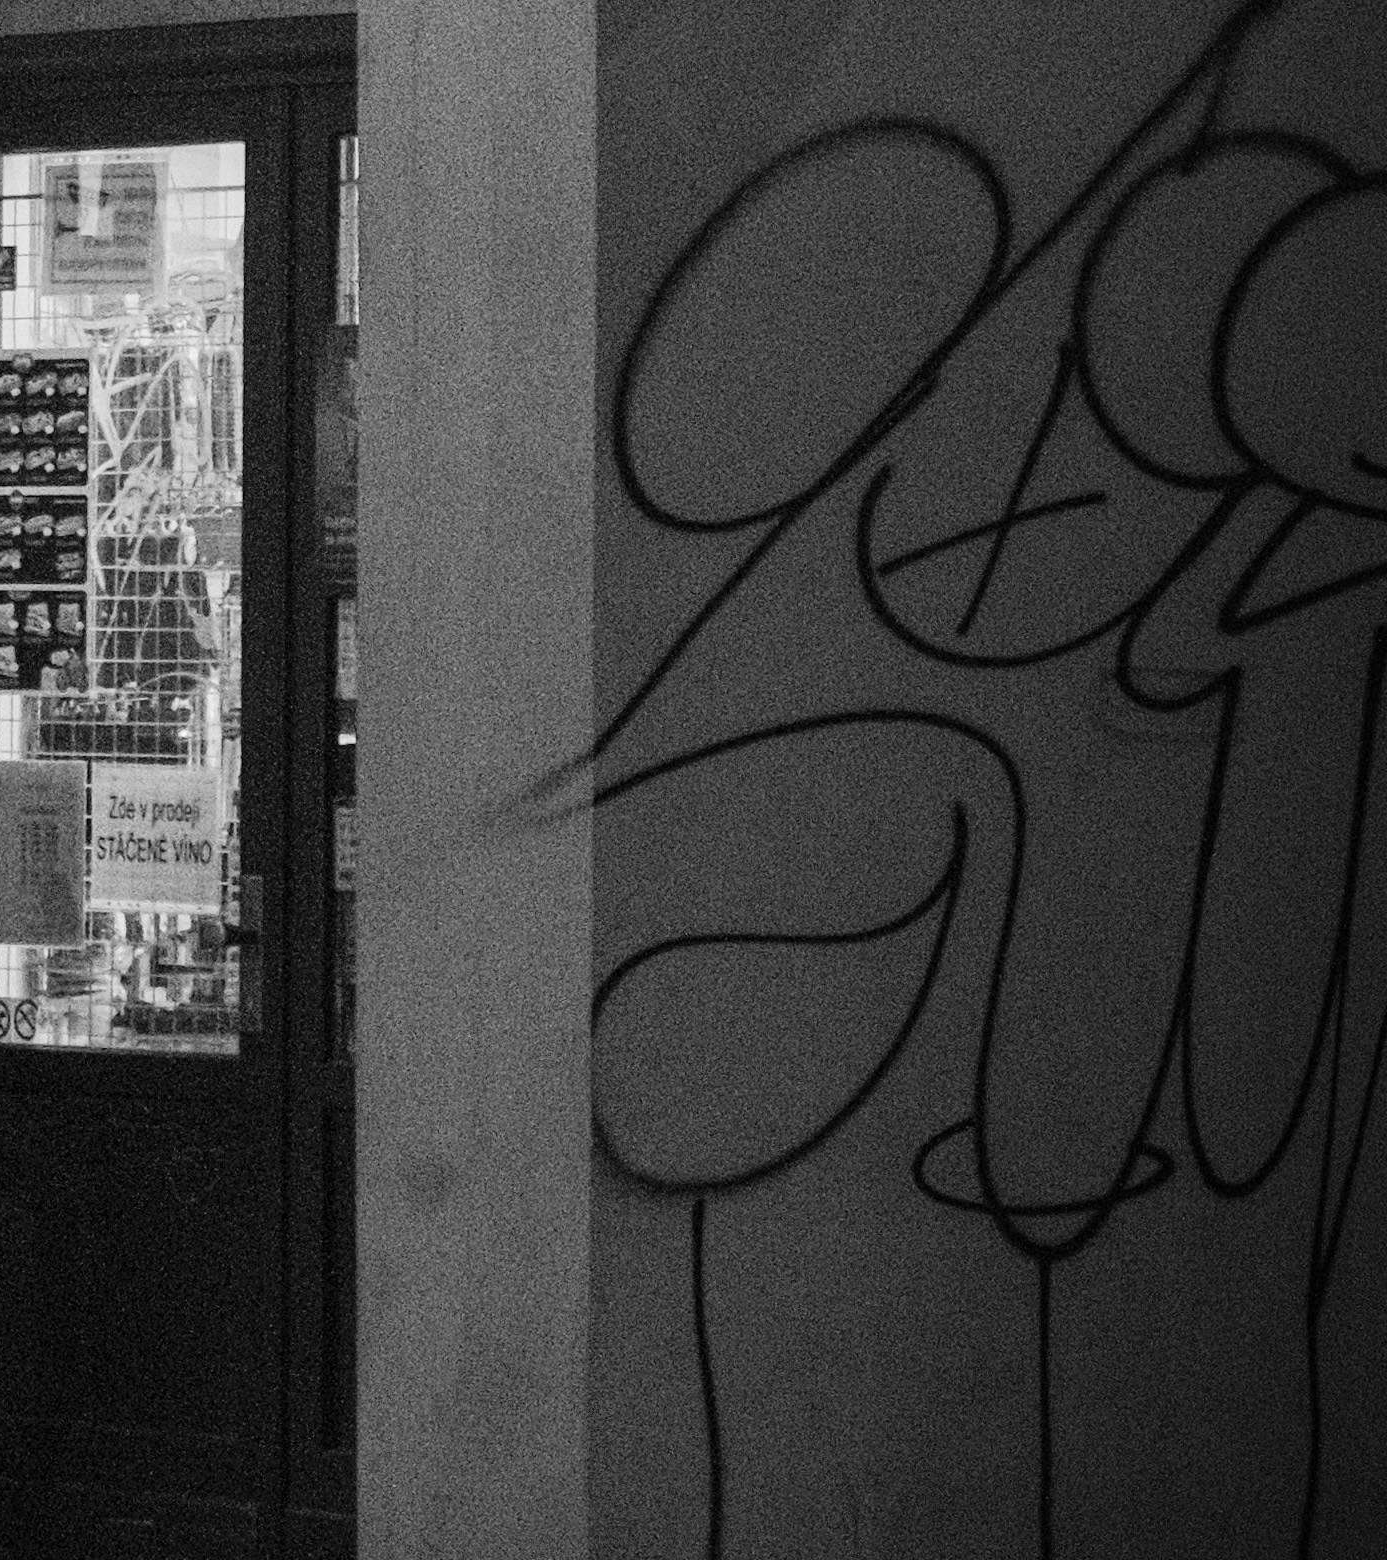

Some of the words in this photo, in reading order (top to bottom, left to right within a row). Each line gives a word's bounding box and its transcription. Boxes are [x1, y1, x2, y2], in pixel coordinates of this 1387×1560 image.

[109, 794, 136, 820] Zde
[139, 801, 148, 821] v
[172, 833, 213, 865] VÍNO
